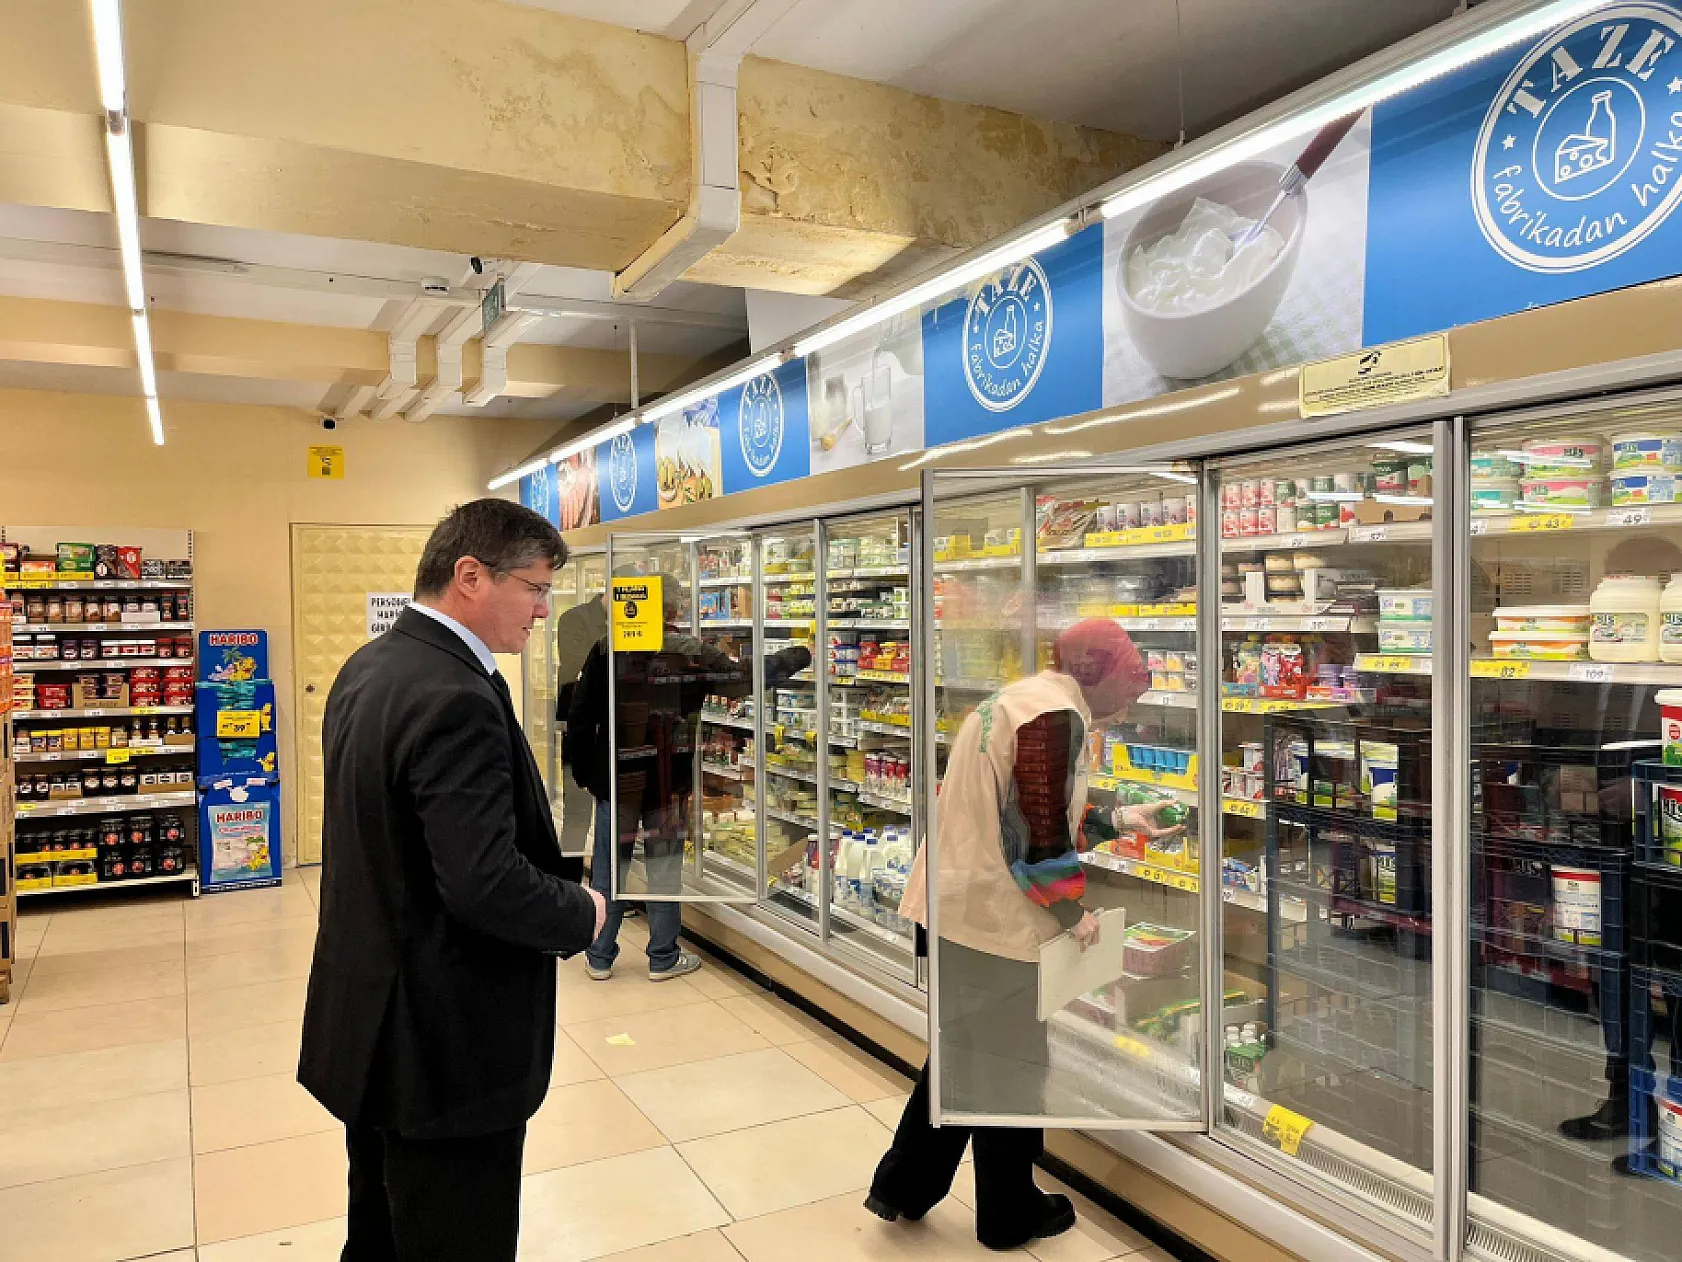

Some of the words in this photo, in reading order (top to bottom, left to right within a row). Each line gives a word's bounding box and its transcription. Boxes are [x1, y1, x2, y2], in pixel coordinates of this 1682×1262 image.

[1507, 23, 1676, 119] TAZE
[1493, 164, 1628, 248] fabrikadan
[210, 633, 258, 646] HARIBO
[216, 810, 263, 824] HARIBO
